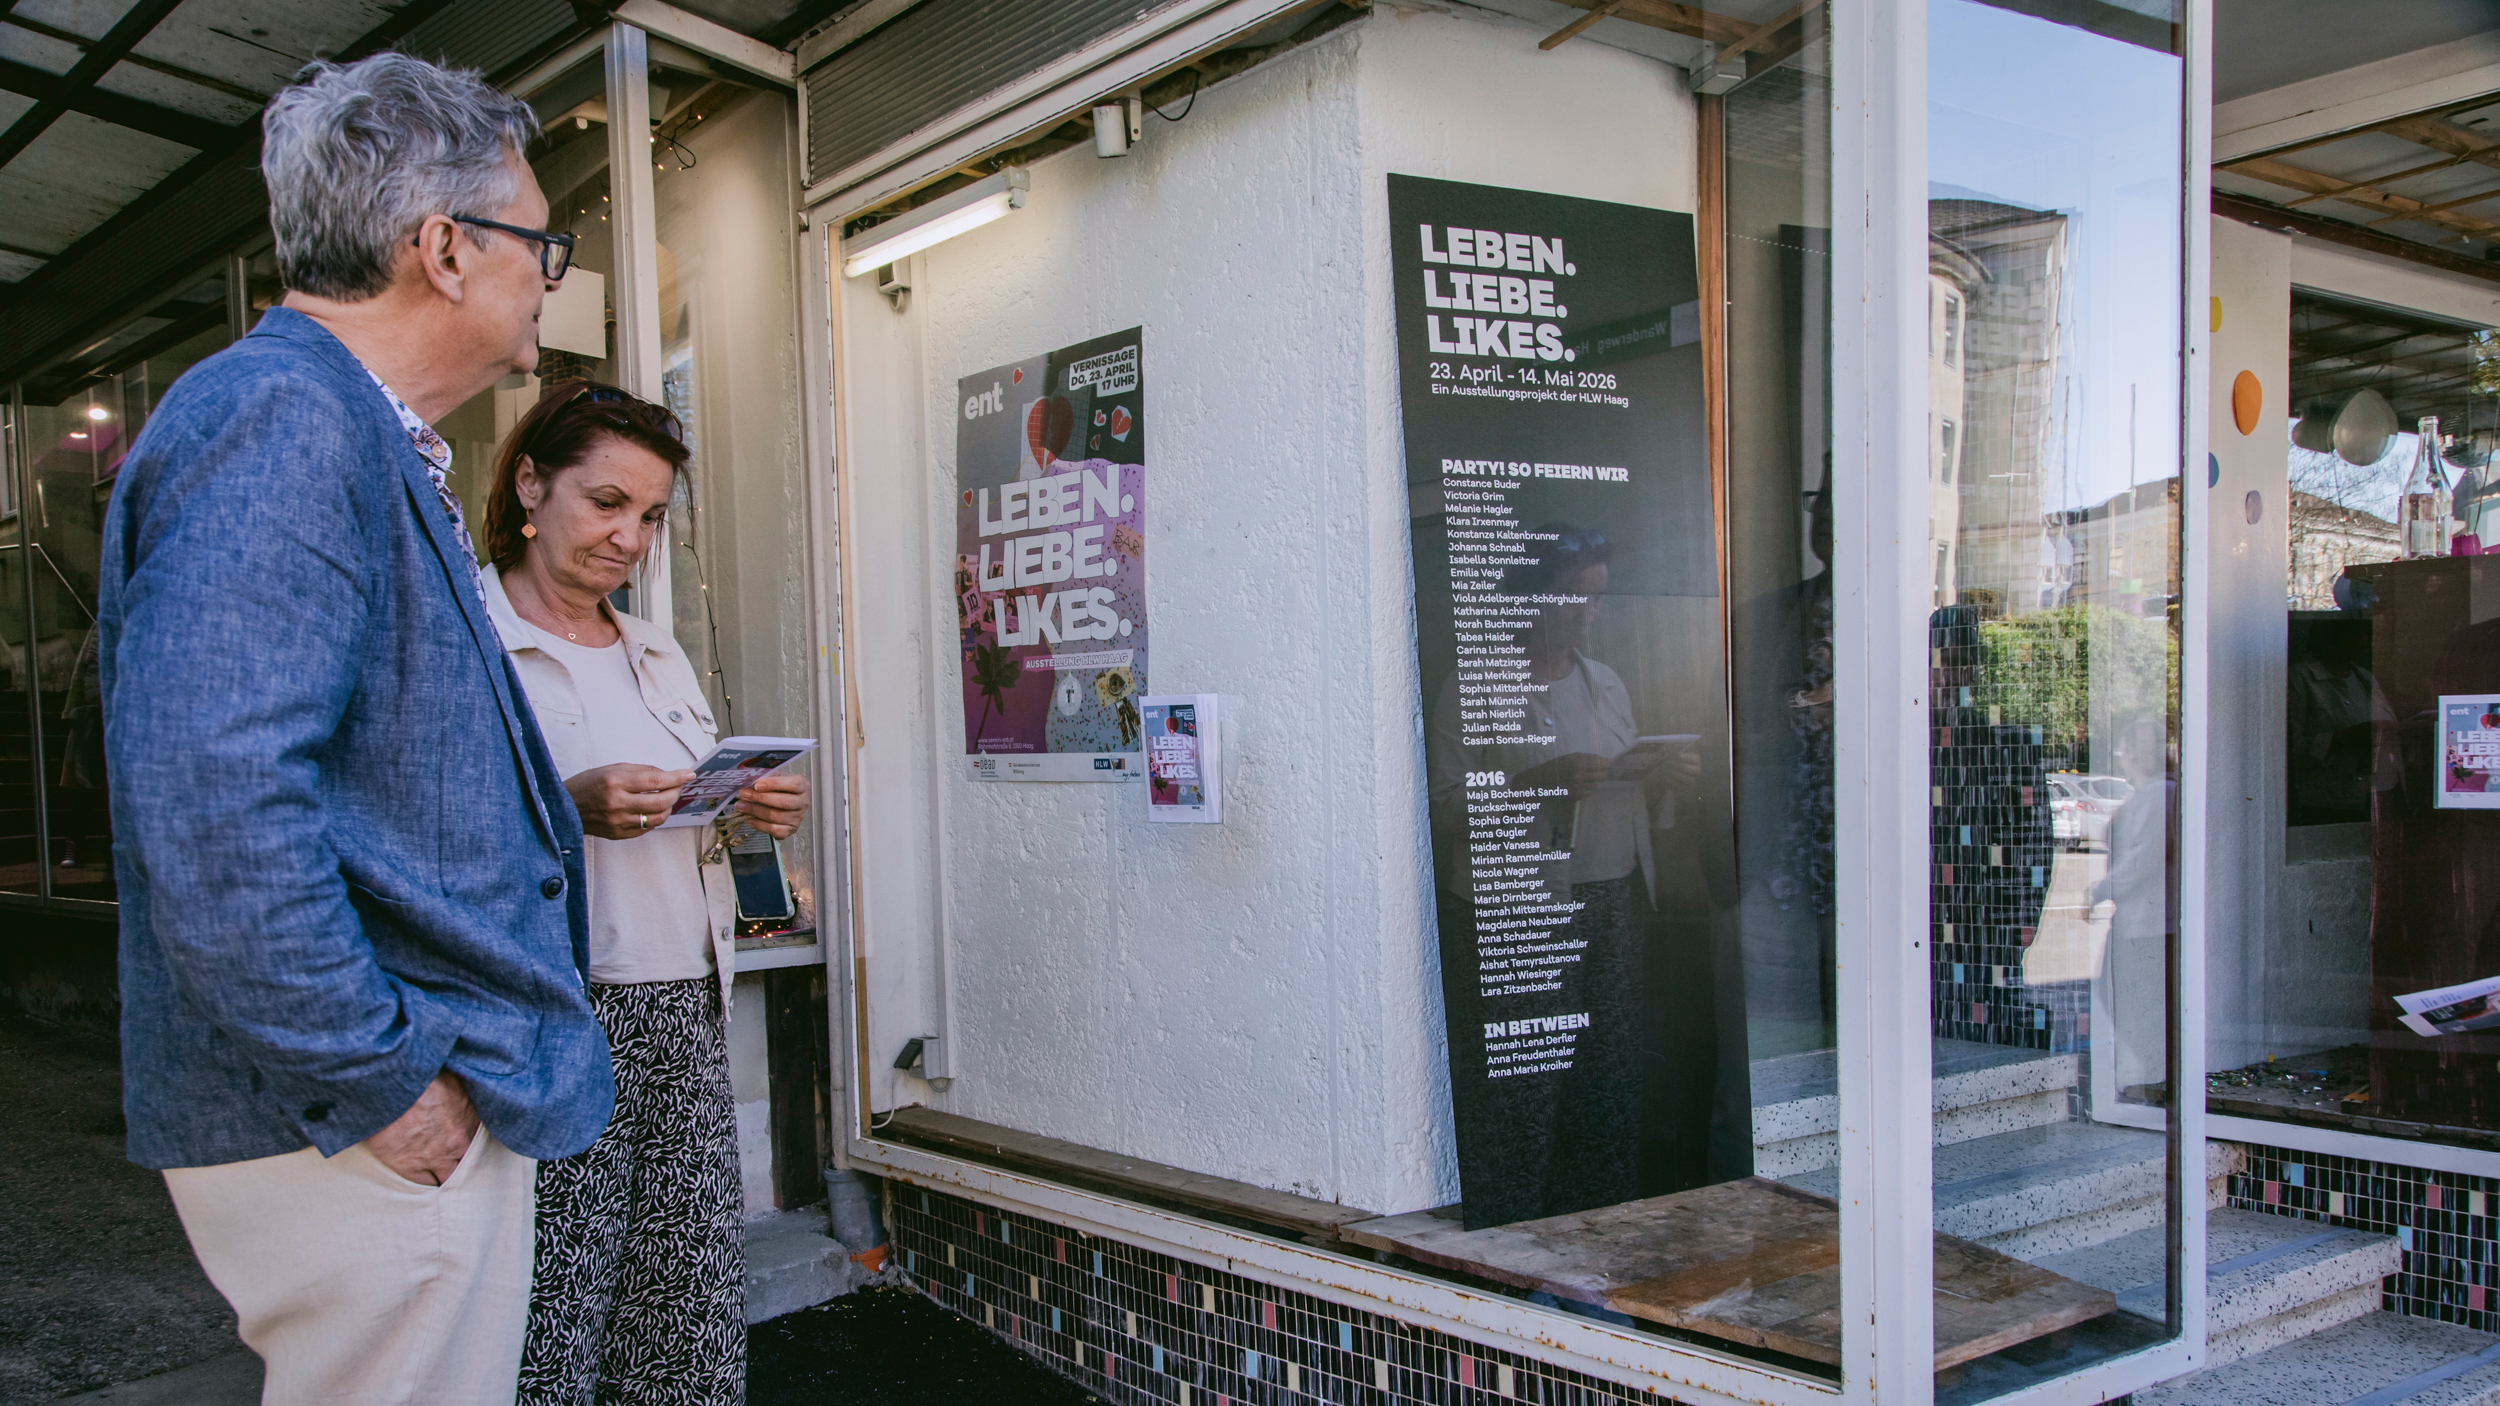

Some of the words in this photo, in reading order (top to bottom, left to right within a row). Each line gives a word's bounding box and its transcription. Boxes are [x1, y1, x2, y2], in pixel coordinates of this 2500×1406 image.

[1420, 224, 1576, 276] LEBEN.
[1423, 269, 1568, 318] LIEBE.
[1427, 314, 1576, 362] LIKES.
[1072, 349, 1135, 373] VERNISSAGE
[1071, 372, 1087, 386] DO,
[1089, 370, 1103, 382] 23.
[1105, 362, 1135, 379] APRIL
[1429, 362, 1455, 379] 23.
[1459, 364, 1504, 386] April
[1518, 368, 1541, 384] 14.
[1545, 369, 1574, 387] Mai
[1577, 372, 1617, 390] 2026
[1101, 379, 1111, 391] 17
[1113, 375, 1135, 388] UHR
[964, 381, 1004, 420] ent
[1431, 383, 1449, 395] Ein
[1451, 384, 1558, 403] Ausstellungsprojekt
[1559, 390, 1577, 402] der
[1579, 392, 1602, 403] HLW
[1604, 394, 1629, 408] Haag
[1441, 459, 1505, 476] PARTY!
[1508, 462, 1532, 477] SO
[1534, 463, 1594, 480] FEIERN
[1595, 466, 1629, 482] WIR
[1443, 477, 1492, 488] Constance
[1494, 479, 1521, 489] Buder
[978, 463, 1134, 538] LEBEN.
[1443, 490, 1480, 500] Victoria
[1481, 492, 1505, 501] Grim
[1445, 503, 1481, 513] Melanie
[1483, 504, 1513, 516] Hagler
[1446, 516, 1471, 526] Klara
[1472, 517, 1519, 529] Irxenmayr
[1447, 529, 1495, 539] Konstanze
[1496, 530, 1560, 541] Kaltenbrunner
[1113, 528, 1140, 557] BAR
[1448, 541, 1488, 552] Johanna
[1489, 542, 1526, 553] Schnabl
[979, 524, 1118, 593] LIEBE.
[1449, 554, 1487, 564] Isabella
[1488, 555, 1540, 565] Sonnleitner
[1450, 567, 1479, 577] Emilia
[1480, 567, 1504, 580] Veigl
[1451, 580, 1468, 590] Mia
[1470, 580, 1496, 590] Zeiler
[1452, 593, 1477, 603] Viola
[1478, 593, 1588, 606] Adelberger-Schörghuber
[993, 586, 1133, 648] LIKES.
[1453, 606, 1498, 616] Katharina
[1499, 606, 1540, 616] Aichhorn
[1454, 619, 1483, 629] Norah
[1484, 619, 1533, 629] Buchmann
[1455, 631, 1483, 642] Tabea
[1485, 631, 1515, 641] Haider
[1456, 645, 1487, 655] Carina
[1489, 644, 1526, 654] Lirscher
[1025, 656, 1081, 669] AUSSTELLUNG
[1082, 656, 1101, 667] HLW
[1102, 653, 1128, 666] HAAG
[1457, 657, 1484, 668] Sarah
[1485, 658, 1531, 669] Matzinger
[1458, 671, 1483, 681] Luisa
[1484, 670, 1532, 682] Merkinger
[1459, 683, 1491, 696] Sophia
[1493, 682, 1549, 693] Mitterlehner
[1460, 696, 1487, 707] Sarah
[1488, 695, 1528, 706] Münnich
[1146, 710, 1159, 719] ent
[1461, 709, 1488, 720] Sarah
[1489, 708, 1525, 718] Nierlich
[2449, 707, 2470, 716] ent
[1462, 722, 1491, 733] Julian
[1462, 736, 1494, 746] Casian
[1496, 734, 1556, 746] Sonca-Rieger
[1465, 770, 1506, 787] 2016
[1466, 790, 1489, 802] Maja
[1491, 787, 1536, 799] Bochenek
[1537, 786, 1568, 797] Sandra
[1467, 801, 1541, 813] Bruckschwaiger
[1468, 815, 1501, 828] Sophia
[1502, 813, 1535, 824] Gruber
[1469, 830, 1494, 839] Anna
[1495, 827, 1527, 840] Gugler
[1470, 841, 1501, 852] Haider
[1502, 841, 1540, 850] Vanessa
[1471, 855, 1504, 865] Miriam
[1505, 850, 1571, 863] Rammelmüller
[1472, 867, 1503, 879] Nicole
[1503, 867, 1539, 878] Wagner
[1494, 879, 1545, 890] Bamberger
[1474, 894, 1501, 905] Marie
[1475, 905, 1511, 918] Hannah
[1512, 900, 1586, 915] Mitteramskogler
[1476, 919, 1527, 933] Magdalena
[1528, 915, 1572, 926] Neubauer
[1477, 935, 1502, 944] Anna
[1503, 930, 1552, 942] Schadauer
[1478, 945, 1515, 957] Viktoria
[1516, 938, 1588, 954] Schweinschaller
[1479, 959, 1509, 971] Aishat
[1510, 954, 1581, 968] Temyrsultanova
[1480, 971, 1516, 984] Hannah
[1517, 969, 1562, 980] Wiesinger
[1481, 987, 1502, 997] Lara
[1503, 980, 1562, 995] Zitzenbacher
[1484, 1022, 1506, 1039] IN
[1508, 1012, 1590, 1036] BETWEEN
[1485, 1038, 1521, 1052] Hannah
[1522, 1038, 1544, 1048] Lena
[1546, 1033, 1577, 1045] Derfler
[1486, 1055, 1511, 1065] Anna
[1512, 1046, 1575, 1062] Freudenthaler
[1488, 1068, 1512, 1079] Anna
[1513, 1063, 1539, 1075] Maria
[1540, 1059, 1573, 1072] Kroiher
